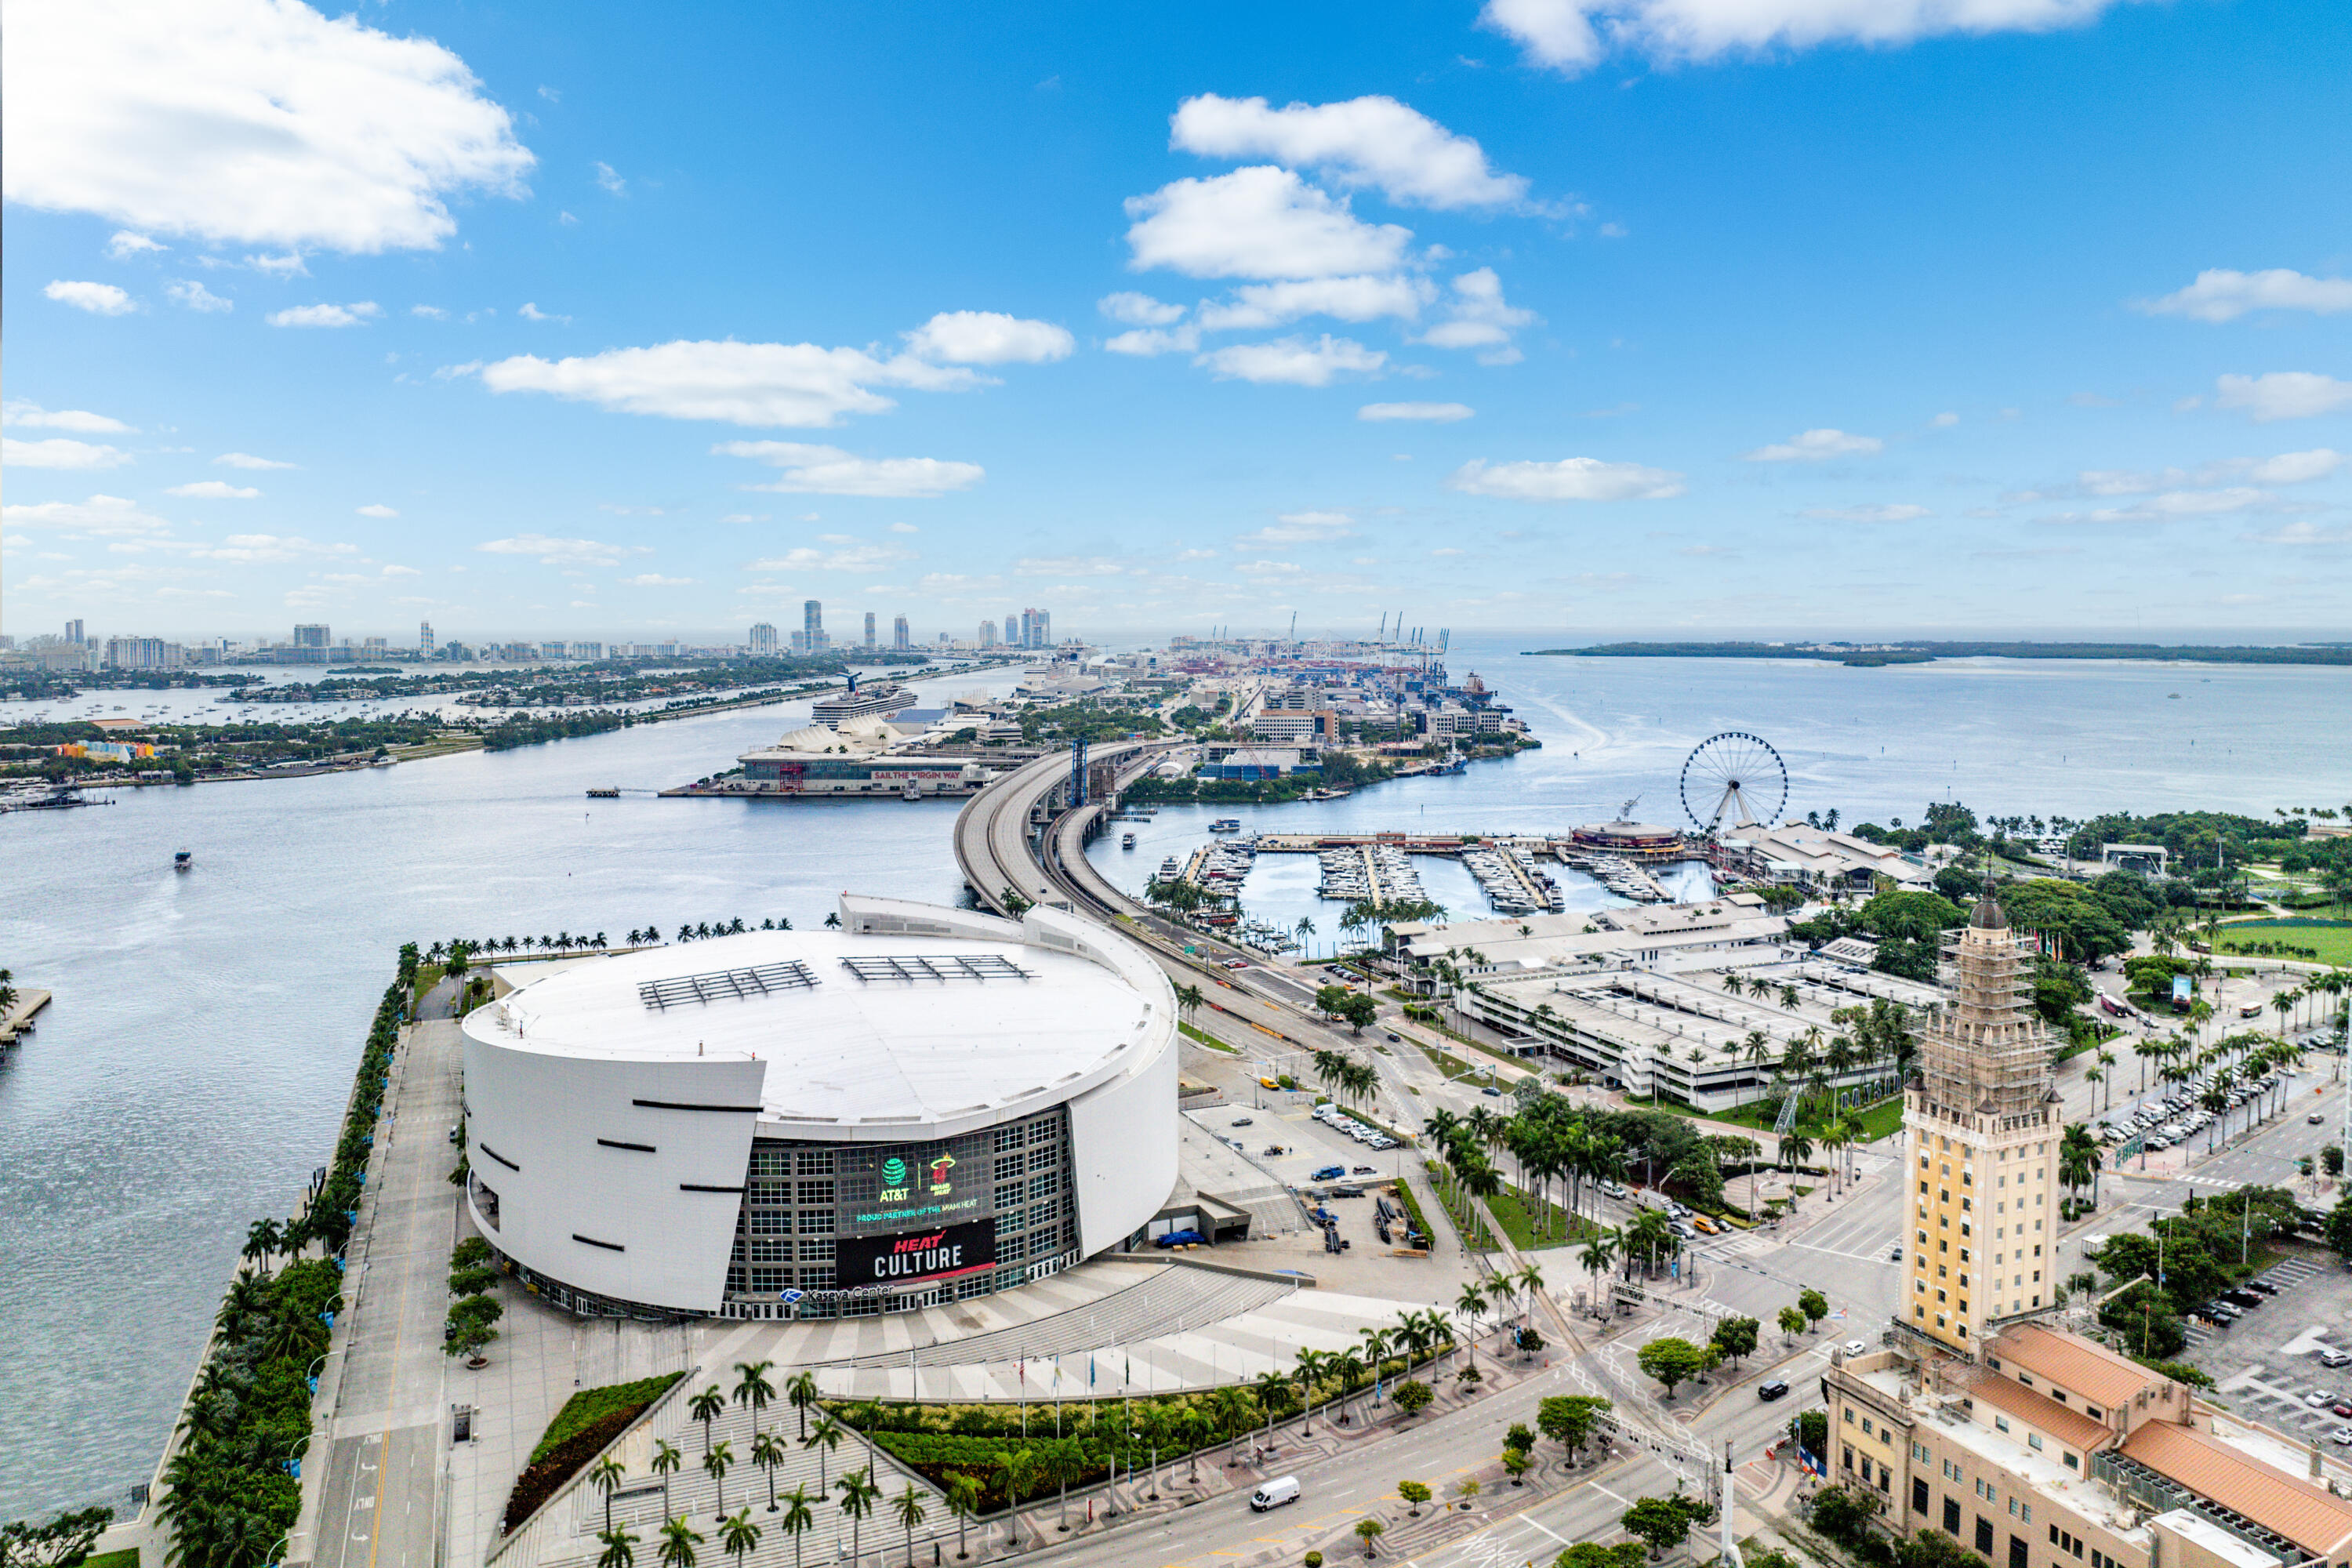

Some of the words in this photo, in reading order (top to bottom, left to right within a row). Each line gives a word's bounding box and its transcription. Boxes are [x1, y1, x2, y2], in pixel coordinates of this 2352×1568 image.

[880, 1189, 909, 1203] AT&T
[856, 1213, 883, 1223] PROUD
[883, 1210, 916, 1221] PARTNER
[916, 1207, 927, 1217] OF
[927, 1205, 942, 1214] THE
[942, 1202, 961, 1212] MIAMI
[961, 1199, 978, 1209] HEAT
[894, 1229, 947, 1254] HEAT
[874, 1245, 962, 1278] CULTURE
[808, 1289, 850, 1302] Kaseya
[852, 1284, 895, 1298] Center
[363, 1433, 383, 1446] ONLY
[354, 1496, 375, 1511] ONLY
